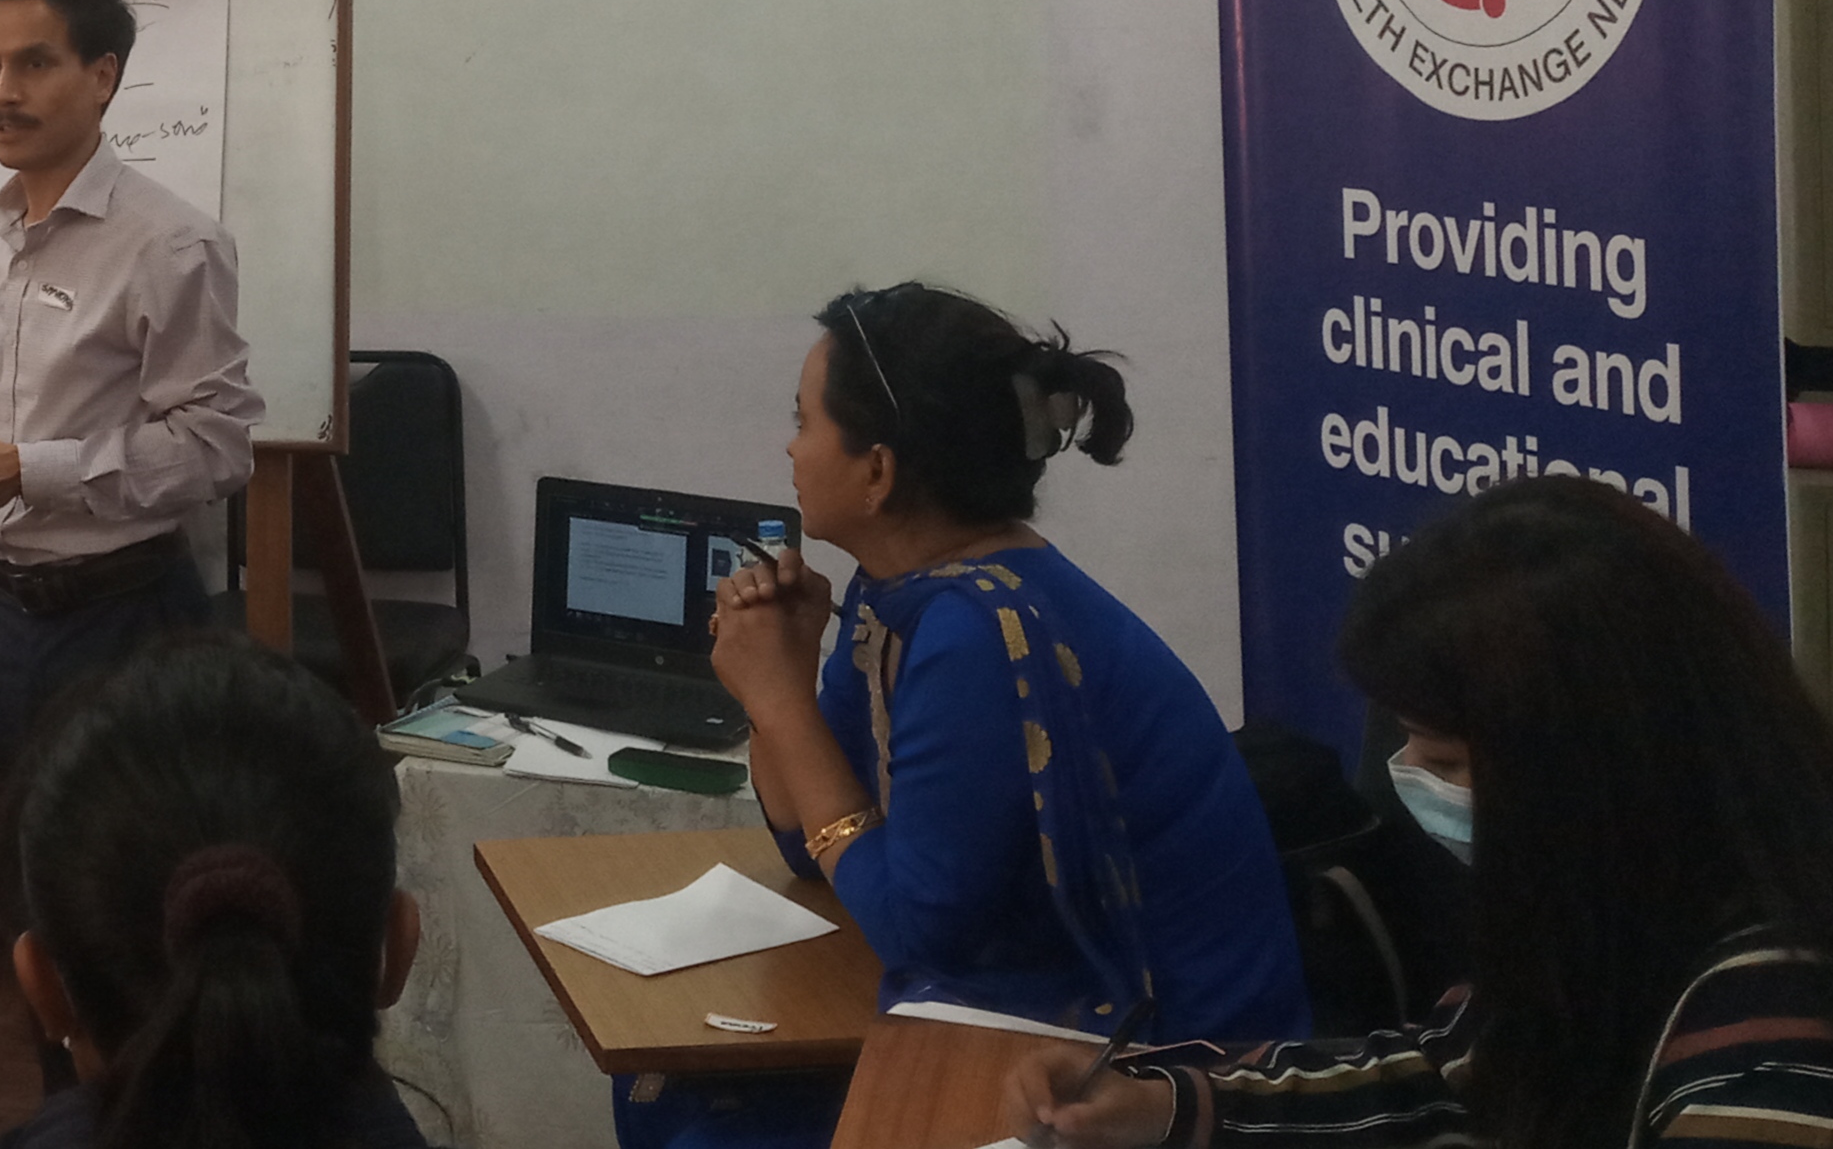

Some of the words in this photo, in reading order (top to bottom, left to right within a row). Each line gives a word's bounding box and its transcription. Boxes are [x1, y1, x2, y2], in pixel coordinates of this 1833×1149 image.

[1407, 28, 1592, 102] EXCHANGE
[1342, 187, 1646, 319] Providing
[1322, 295, 1530, 396] clinical
[1552, 343, 1681, 424] and
